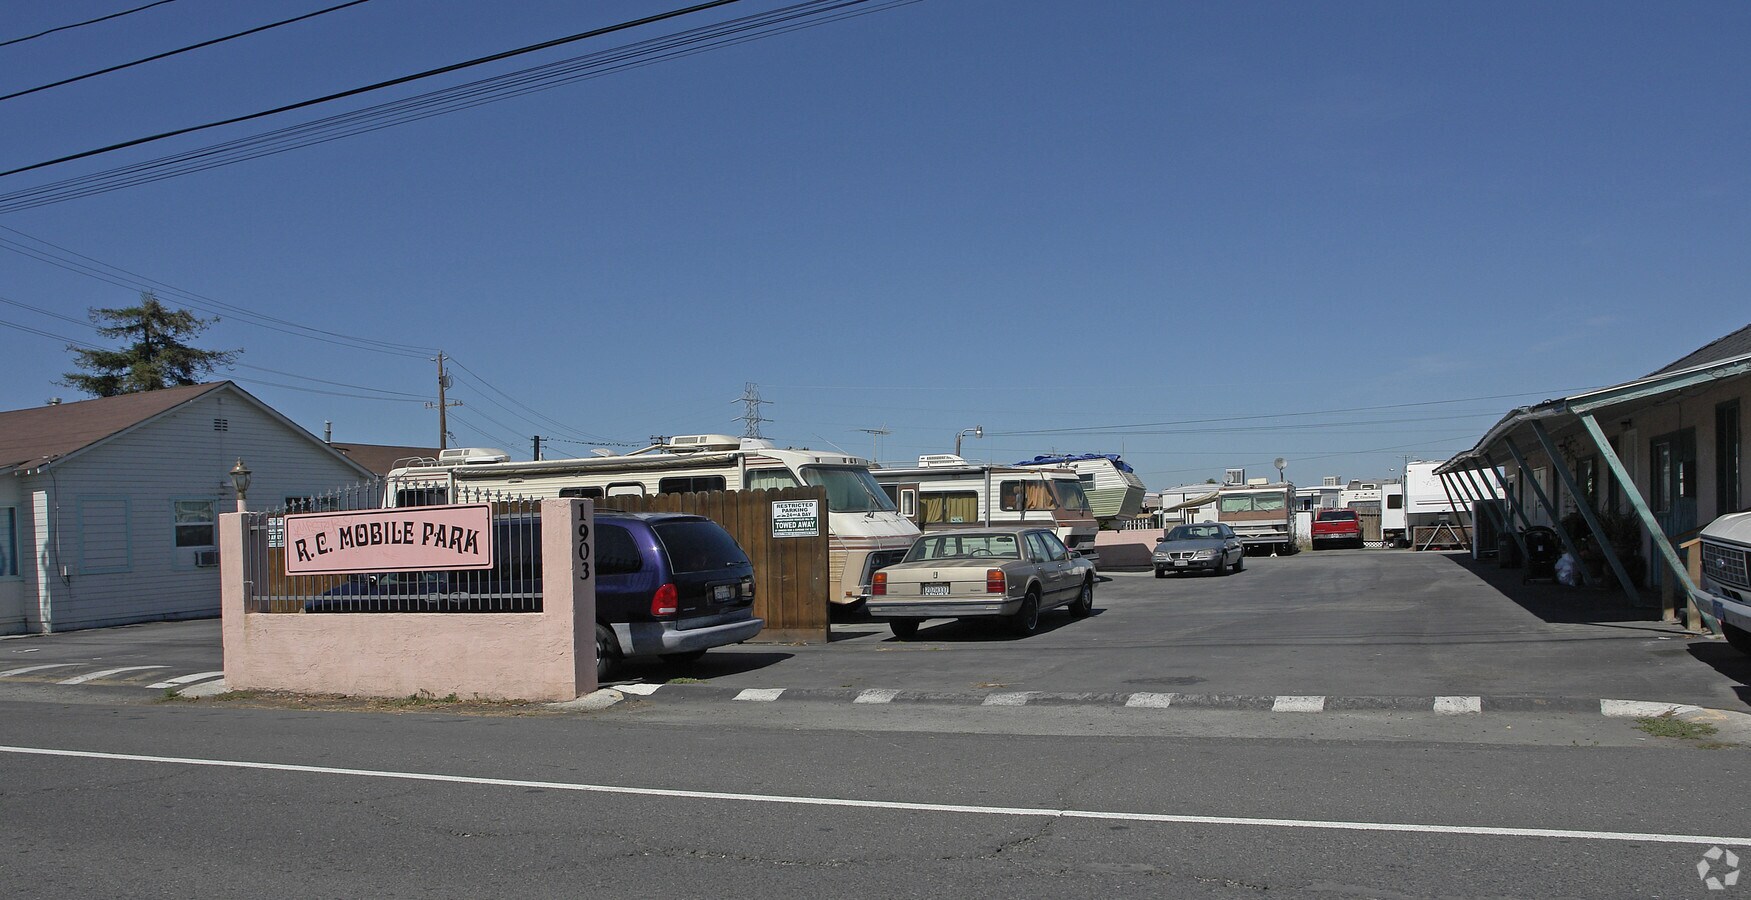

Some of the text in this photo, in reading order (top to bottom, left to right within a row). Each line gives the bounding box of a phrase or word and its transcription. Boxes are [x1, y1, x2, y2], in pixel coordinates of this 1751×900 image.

[339, 521, 414, 550] MOBILE
[422, 522, 480, 555] PARK
[578, 503, 590, 580] 1903
